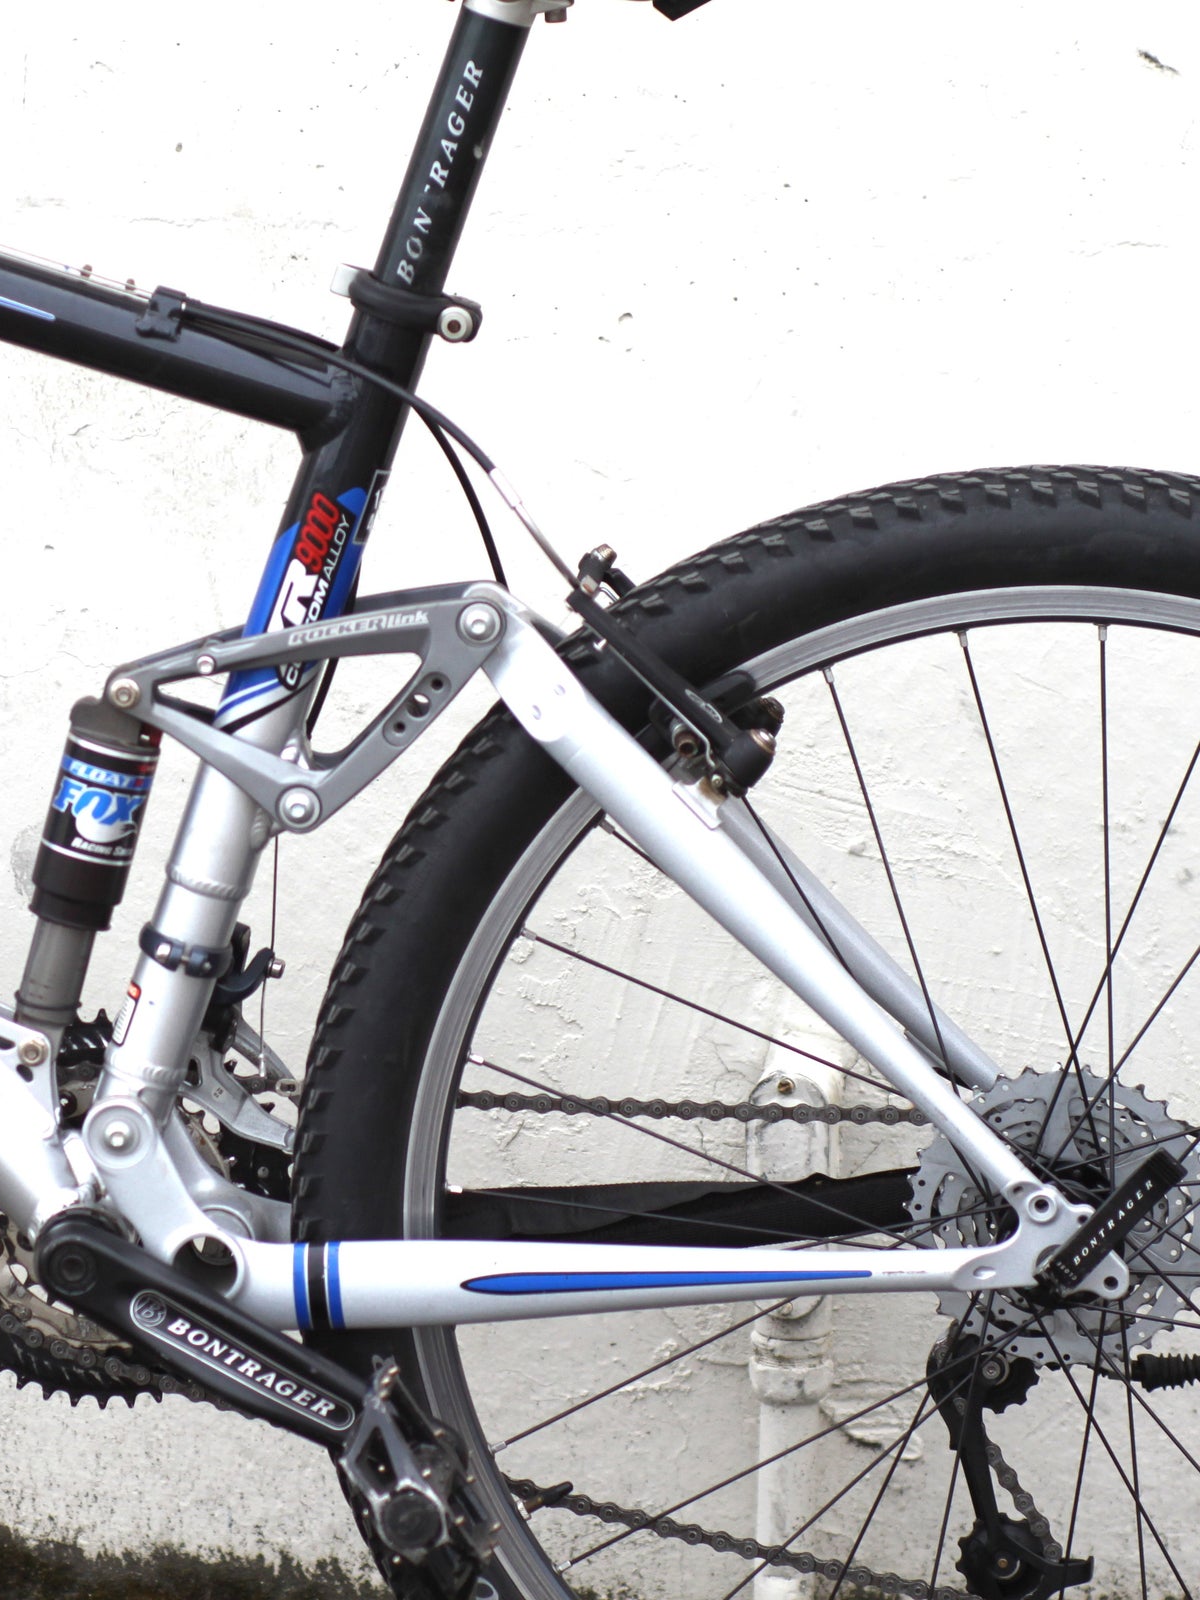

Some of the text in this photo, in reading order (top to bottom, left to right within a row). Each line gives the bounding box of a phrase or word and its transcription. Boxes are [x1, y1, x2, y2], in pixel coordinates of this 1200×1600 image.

[396, 59, 484, 285] BONRAGER
[323, 513, 350, 580] ALLOY
[52, 776, 147, 826] FOX
[69, 759, 131, 788] FLOAT
[1073, 1179, 1154, 1266] BONTRAGER
[167, 1318, 336, 1417] BONTRAGER
